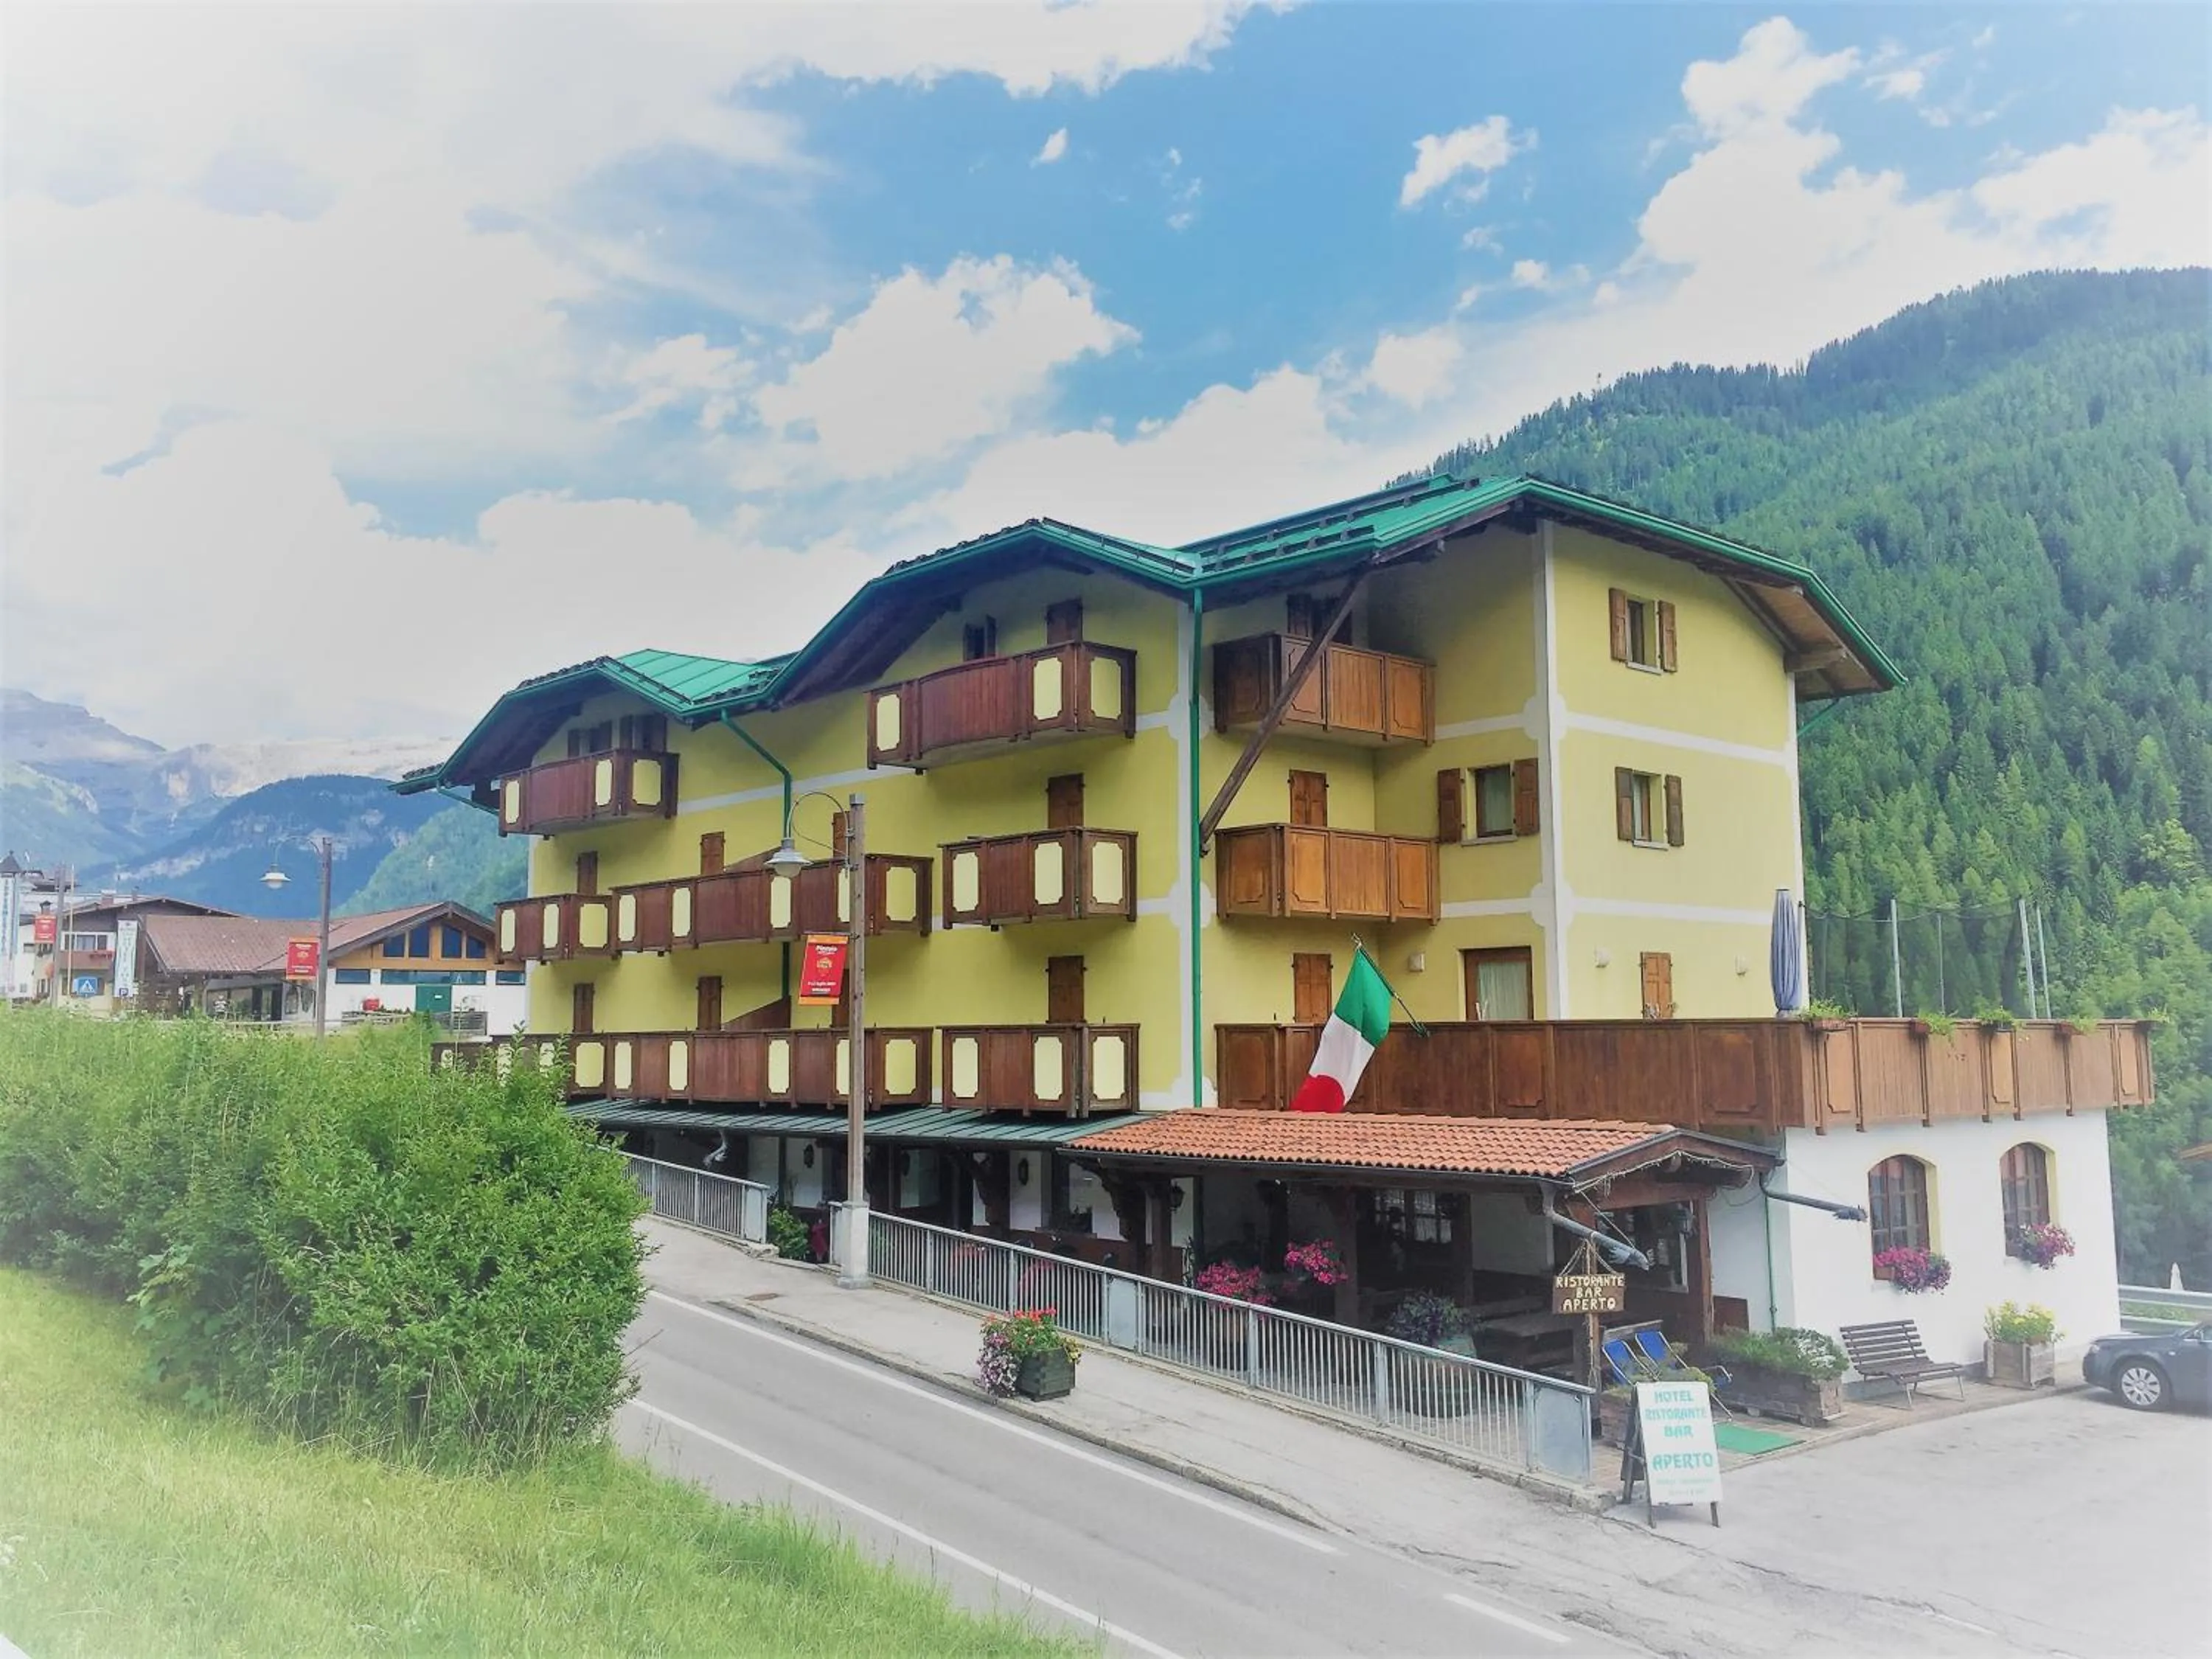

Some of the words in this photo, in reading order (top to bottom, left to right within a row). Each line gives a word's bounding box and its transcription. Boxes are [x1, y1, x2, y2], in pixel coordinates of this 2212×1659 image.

[1557, 1276, 1624, 1288] RISTORANTE
[1576, 1287, 1602, 1298] BAR
[1562, 1298, 1616, 1311] APERTO
[1655, 1390, 1694, 1403] HOTEL
[1645, 1407, 1708, 1420] RISTORANTE
[1664, 1425, 1694, 1438] BAR
[1652, 1453, 1714, 1471] APERTO
